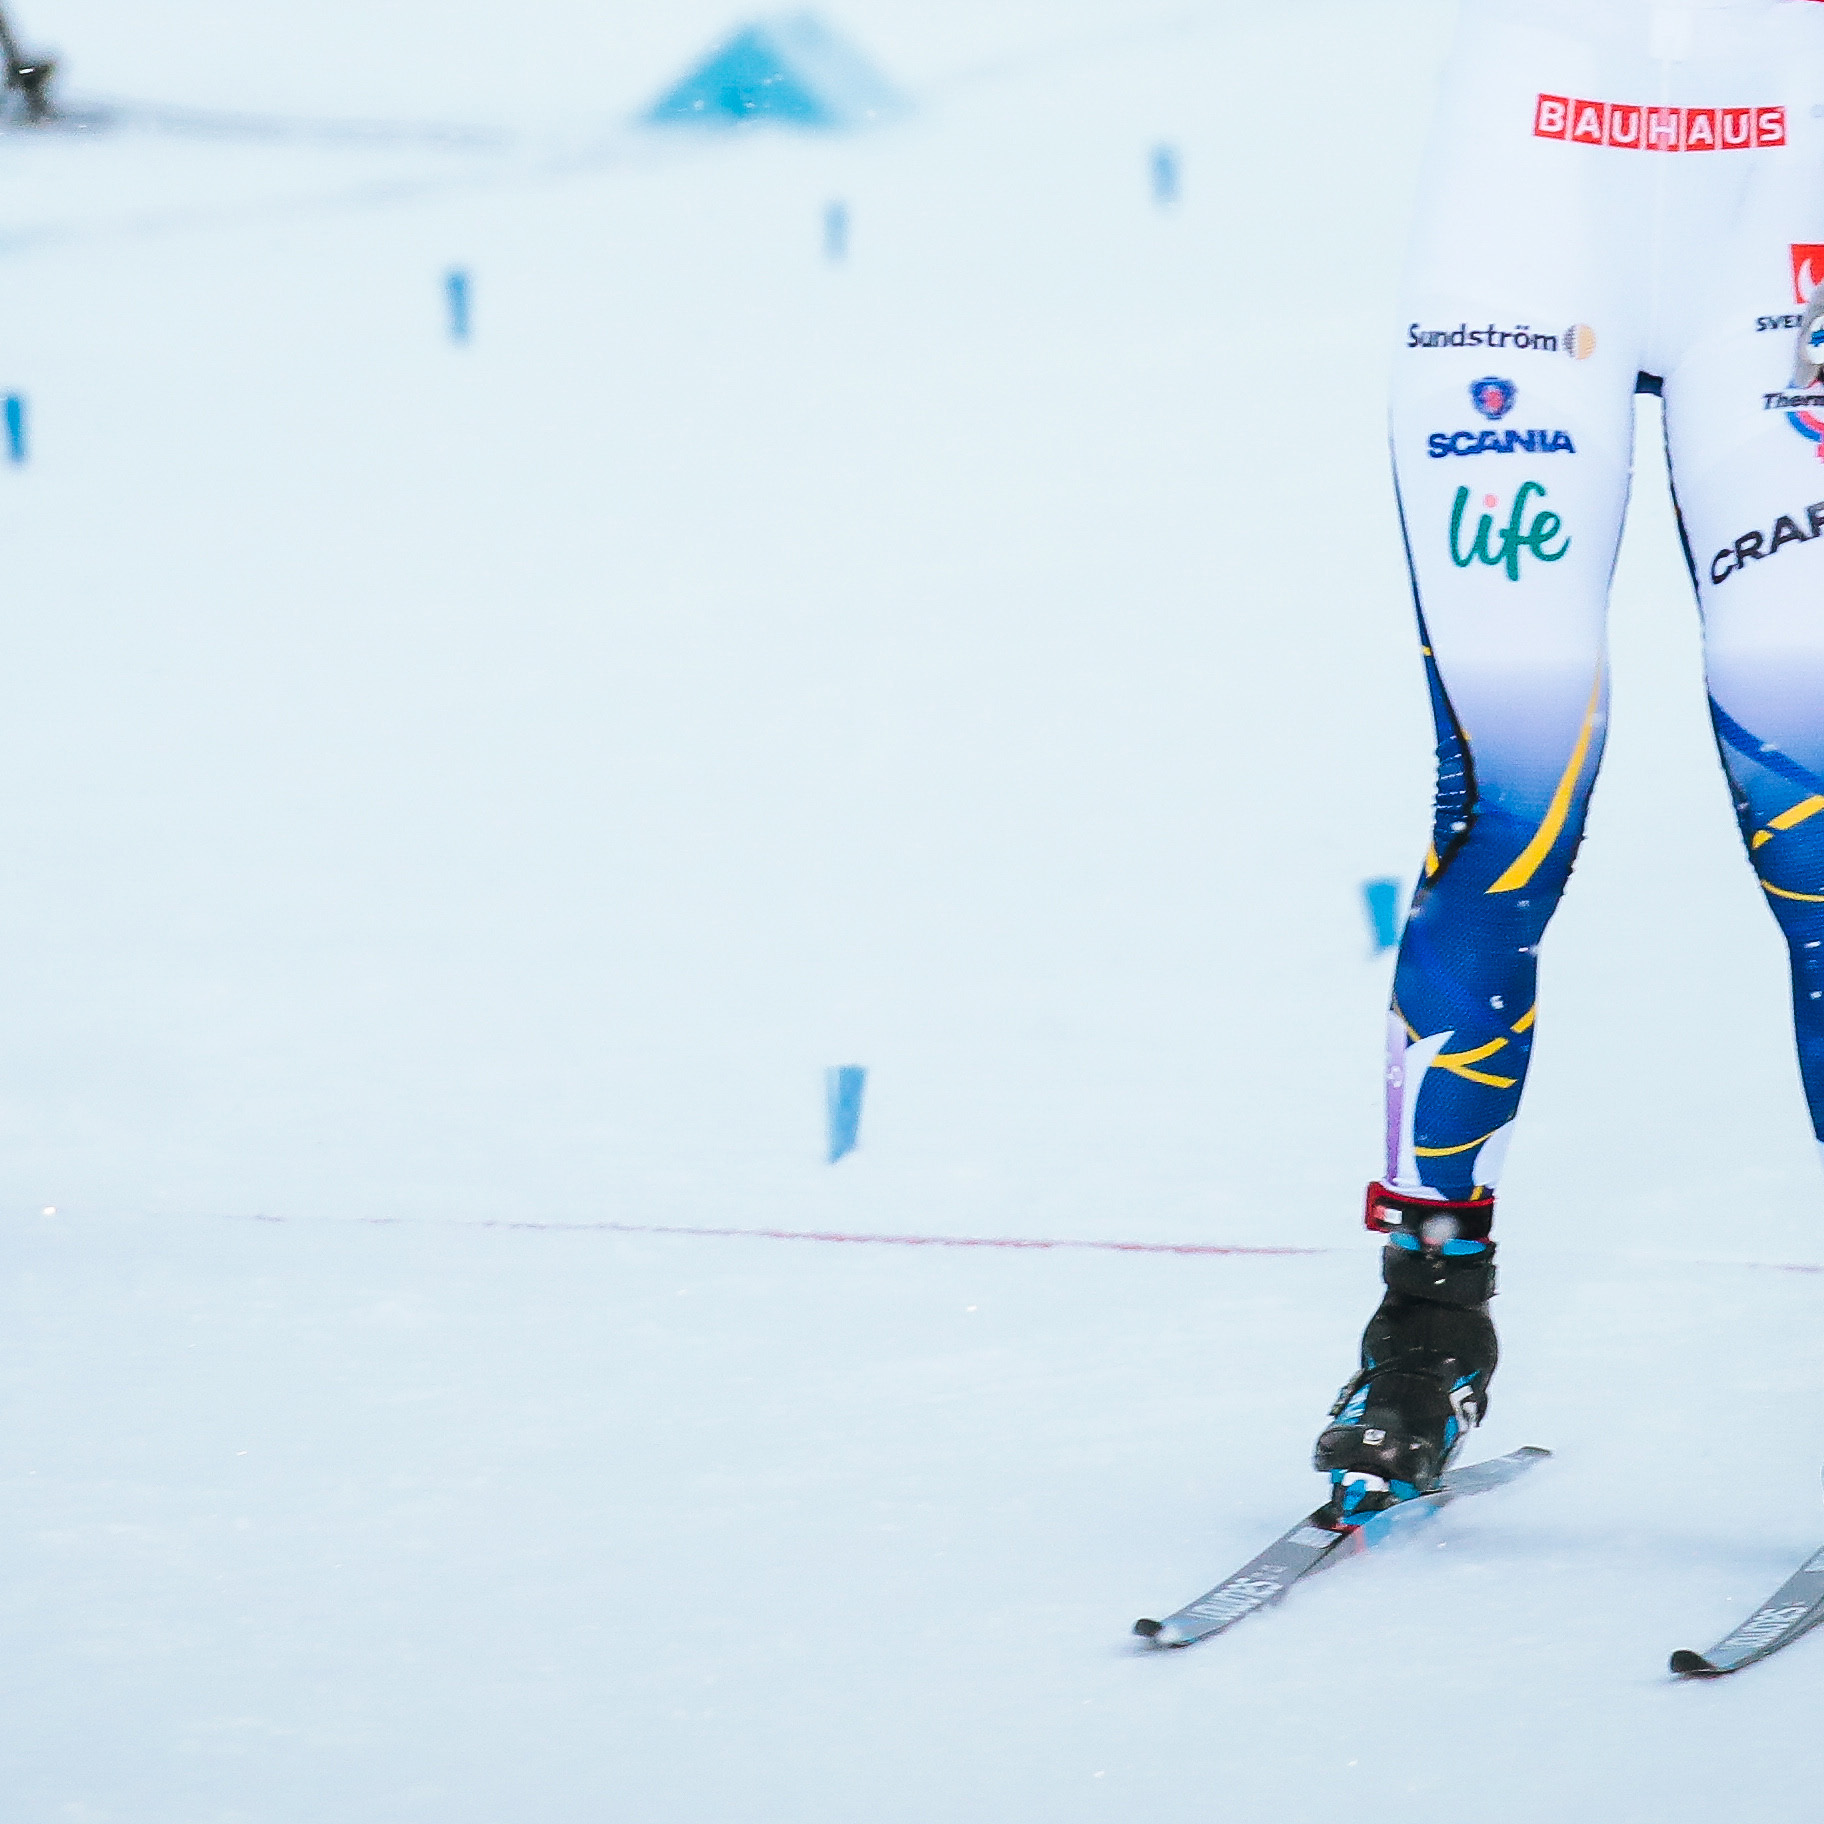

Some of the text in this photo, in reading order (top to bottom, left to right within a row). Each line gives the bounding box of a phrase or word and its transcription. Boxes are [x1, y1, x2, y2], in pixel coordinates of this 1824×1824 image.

[1535, 99, 1785, 147] BAUHAUS
[1406, 323, 1558, 353] Sundström
[1755, 314, 1804, 332] SVE
[1428, 429, 1577, 459] SCANIA
[1448, 480, 1571, 582] life
